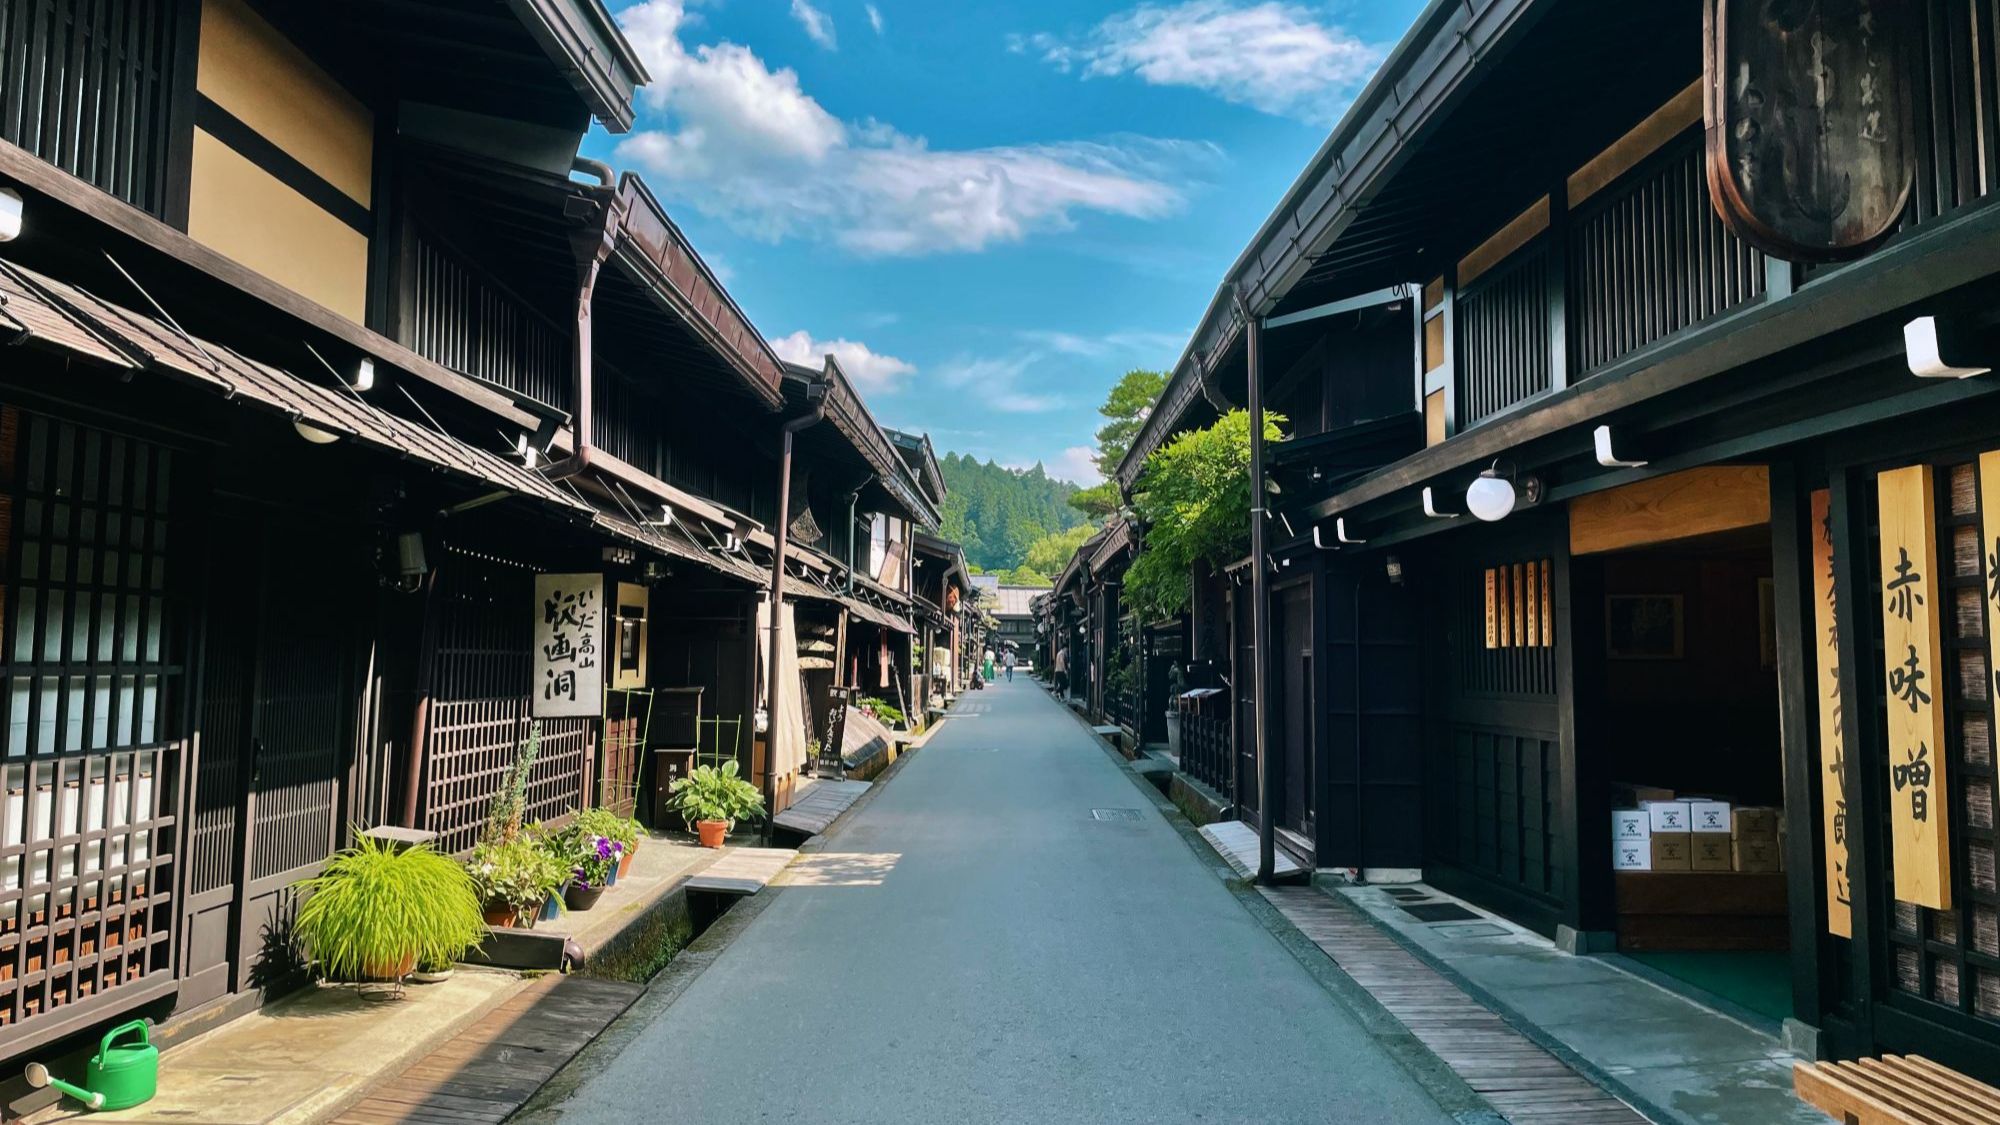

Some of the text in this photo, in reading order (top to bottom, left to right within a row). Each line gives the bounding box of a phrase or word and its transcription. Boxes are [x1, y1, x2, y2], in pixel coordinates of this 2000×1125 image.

[544, 590, 580, 701] 版画洞
[578, 590, 598, 669] ひだ高山
[1887, 547, 1931, 823] 赤味噌
